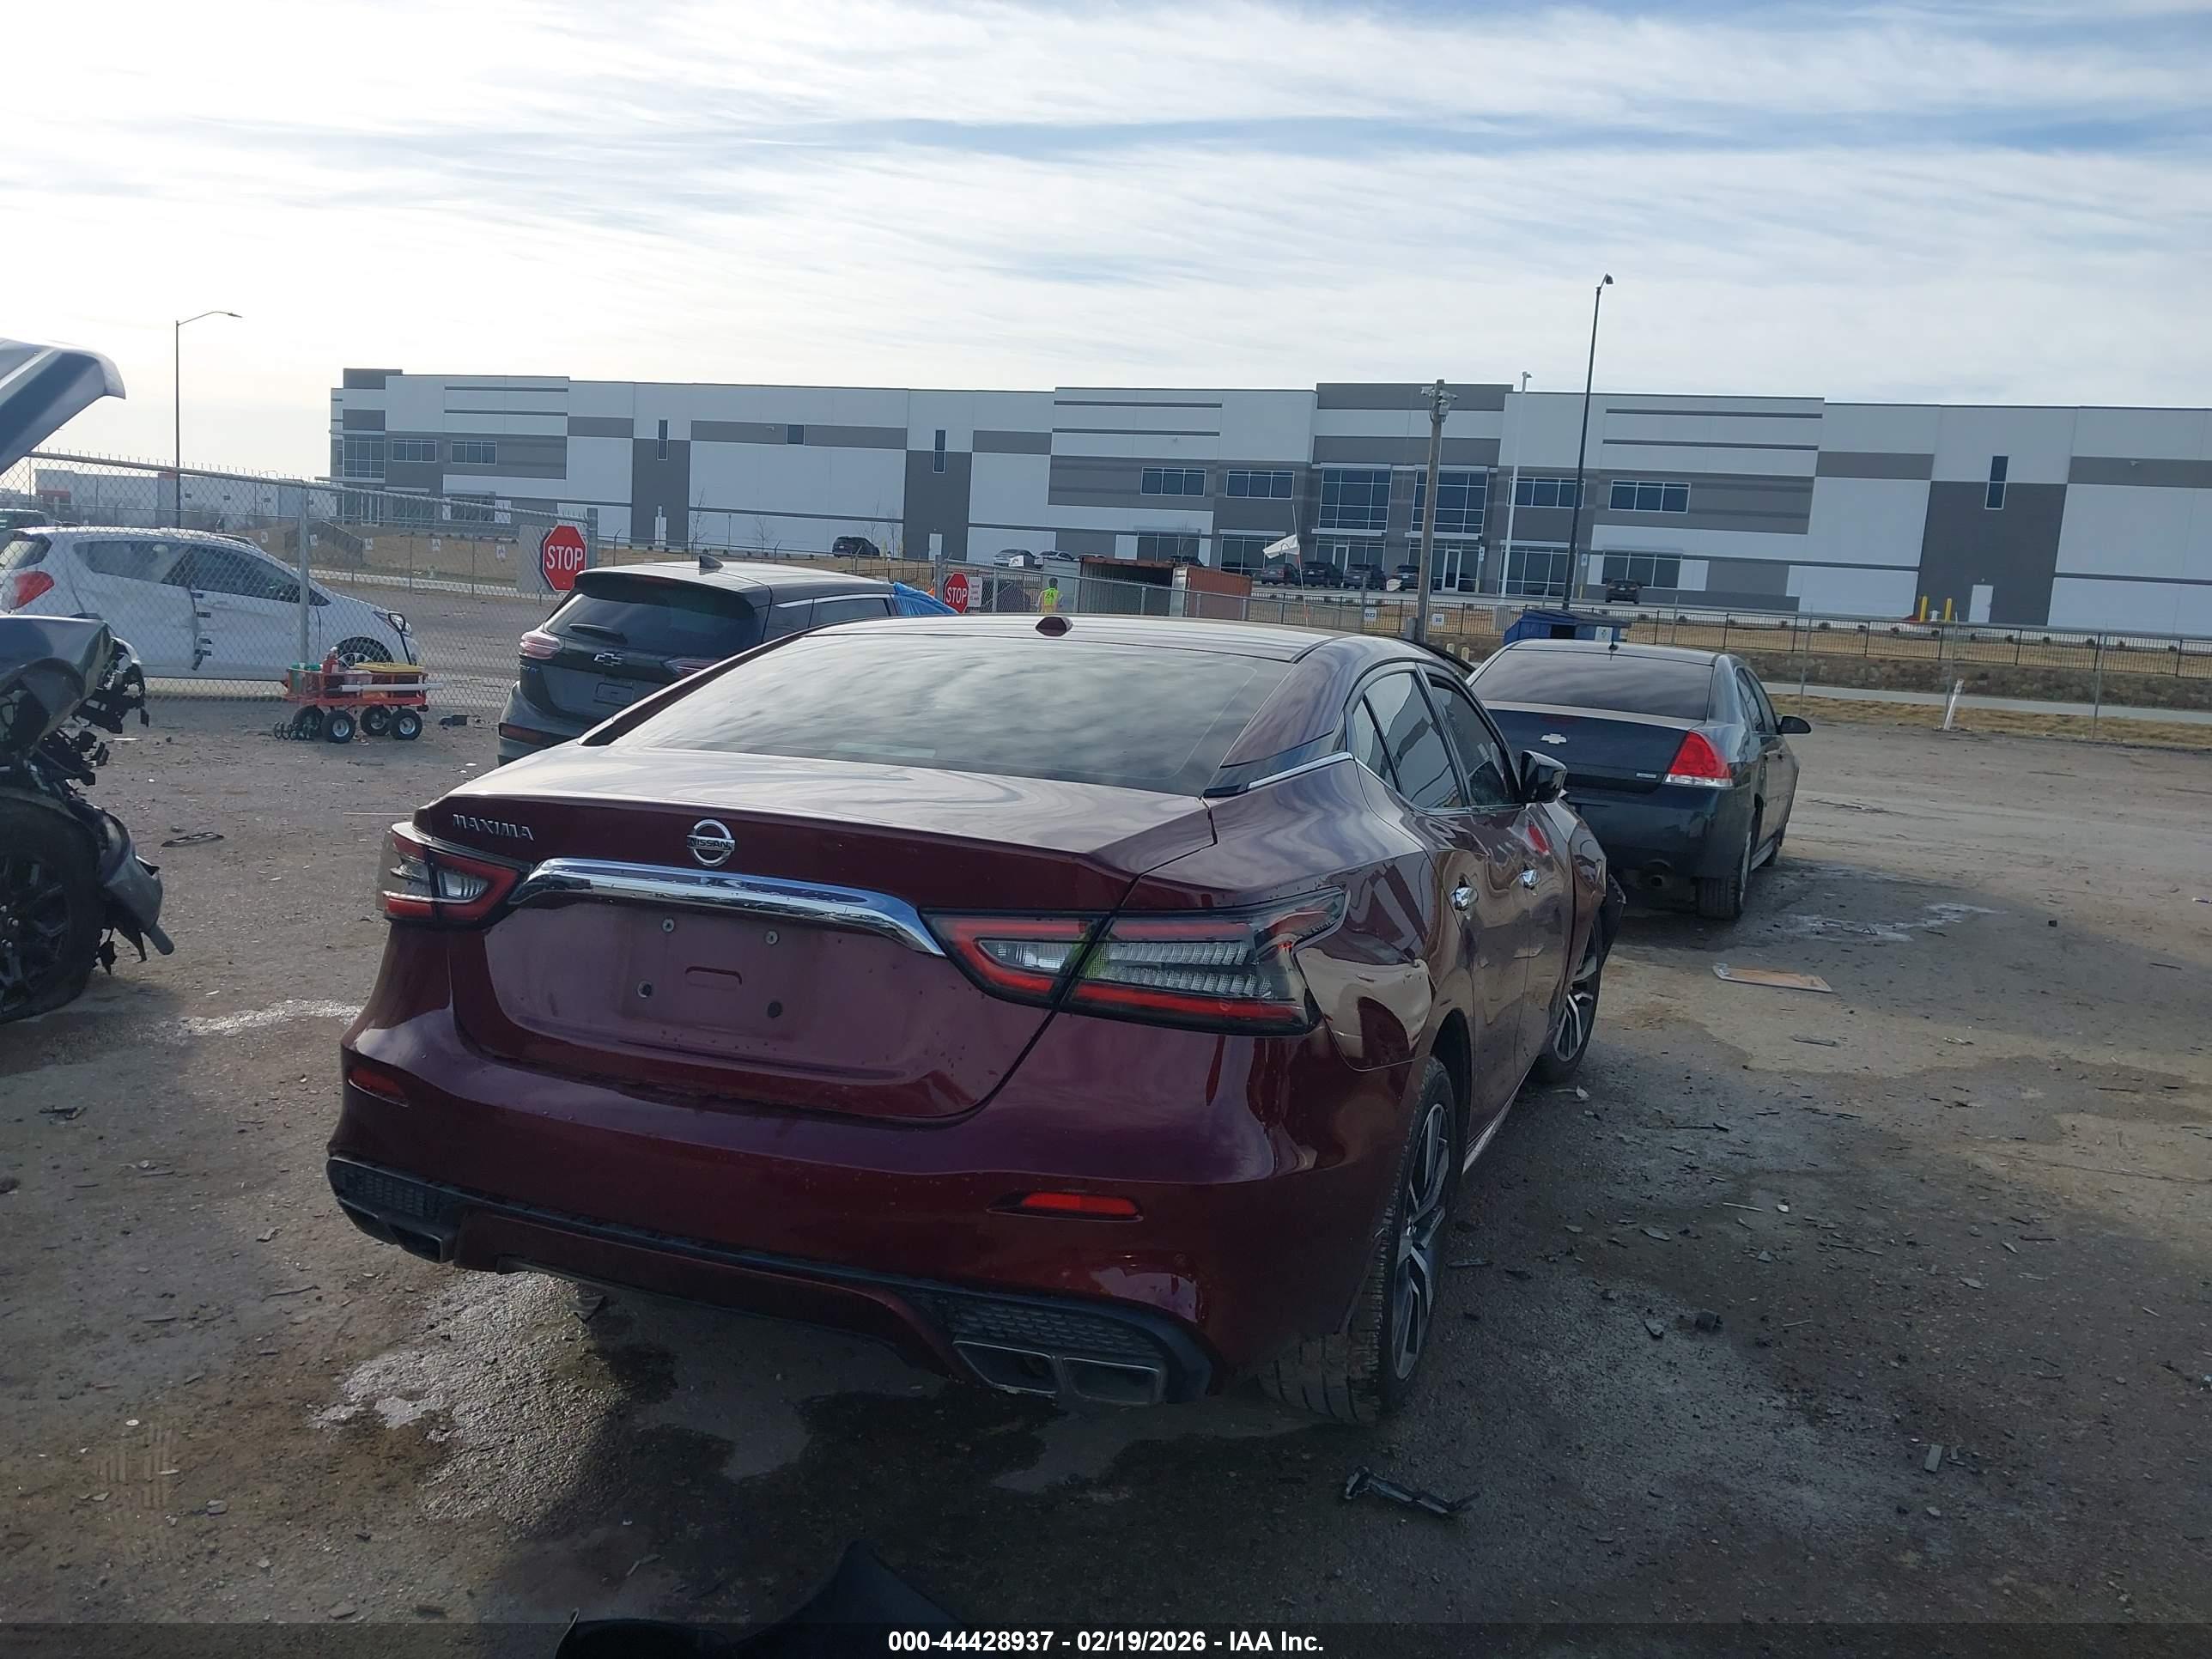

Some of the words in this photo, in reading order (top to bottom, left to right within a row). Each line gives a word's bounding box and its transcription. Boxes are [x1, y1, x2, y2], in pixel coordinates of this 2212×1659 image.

[546, 545, 584, 571] STOP
[945, 586, 968, 604] STOP
[452, 814, 535, 841] MAXIMA
[690, 838, 732, 850] NISSAN
